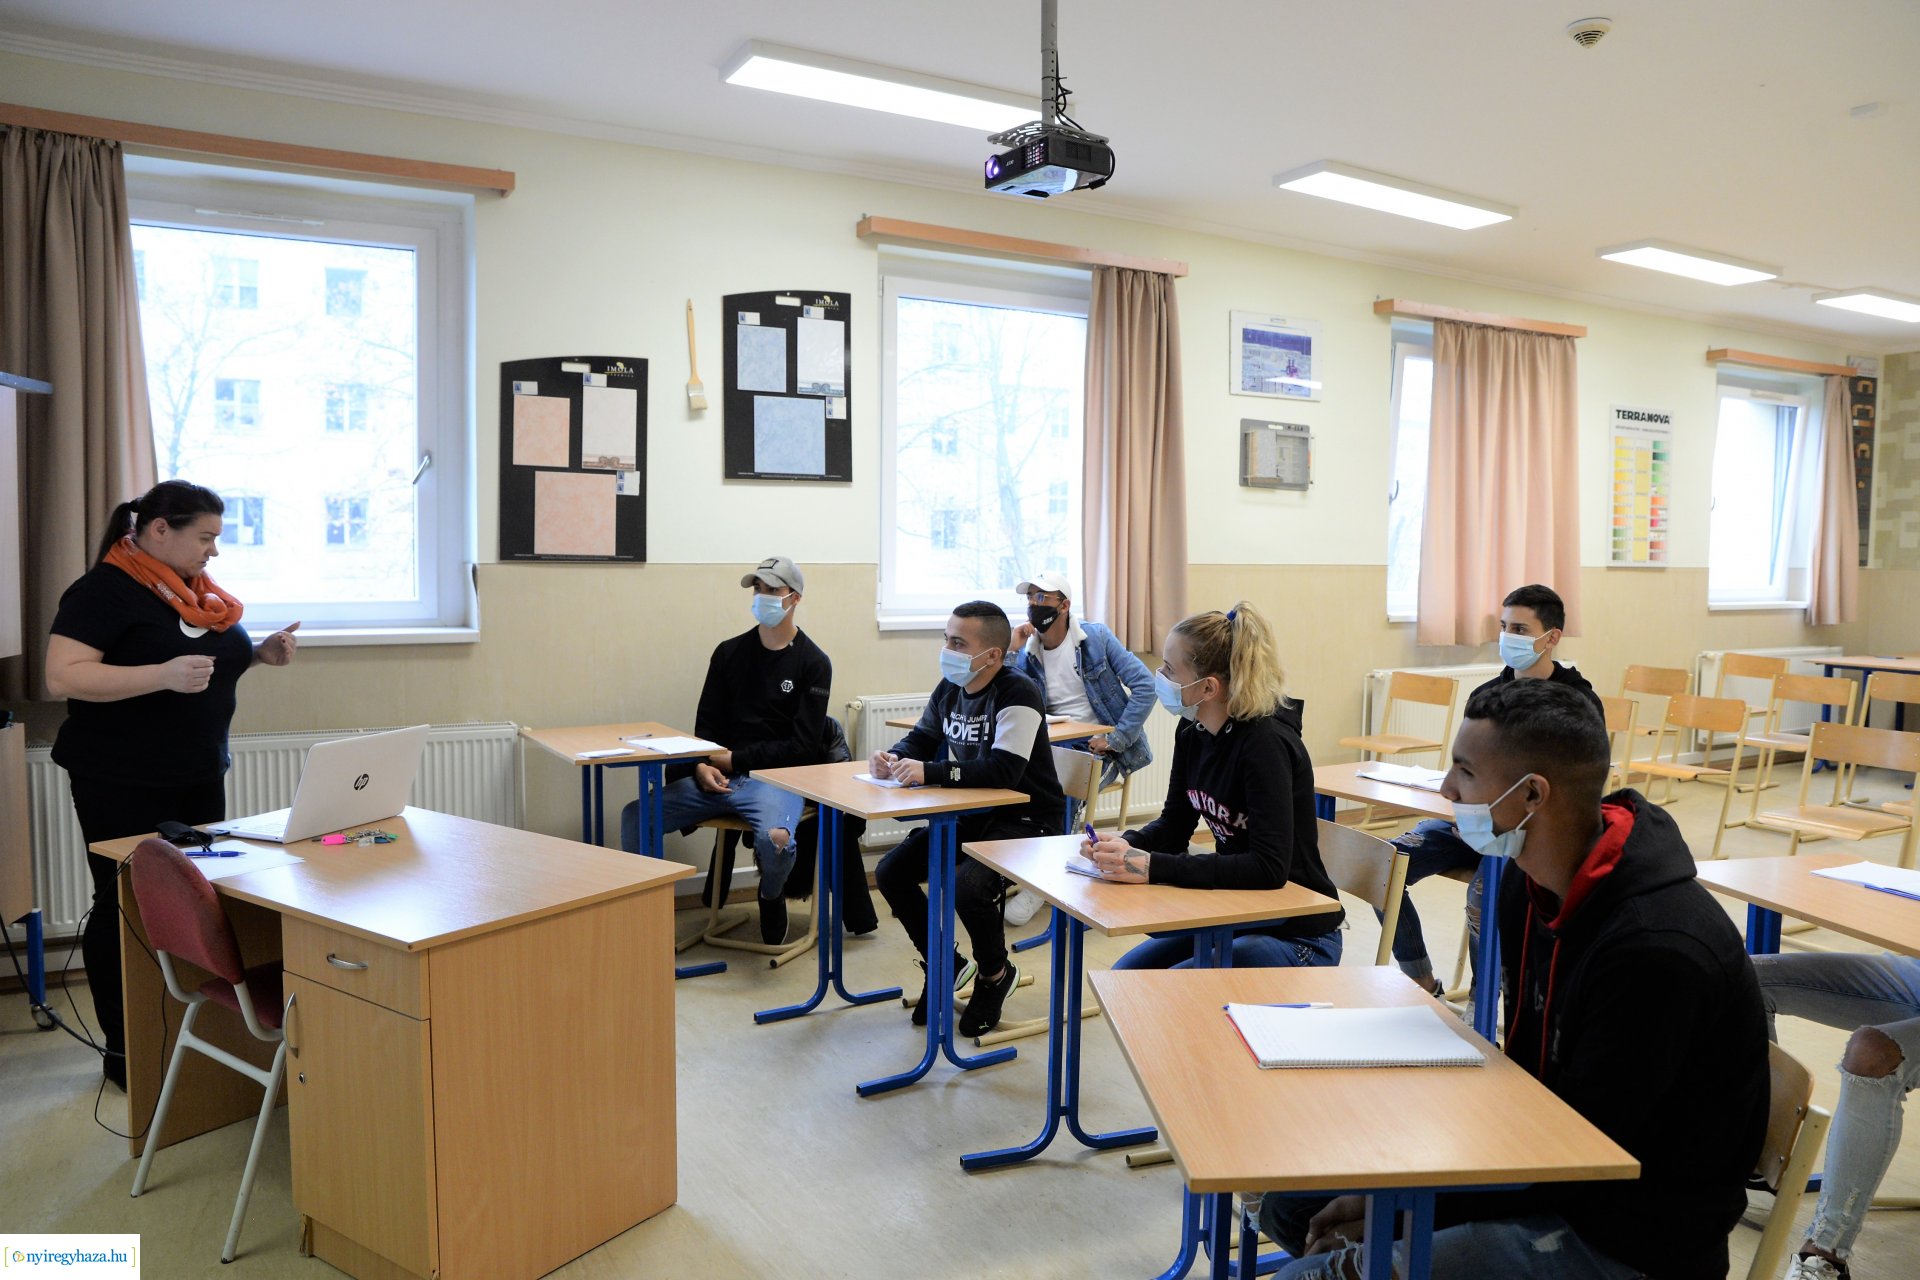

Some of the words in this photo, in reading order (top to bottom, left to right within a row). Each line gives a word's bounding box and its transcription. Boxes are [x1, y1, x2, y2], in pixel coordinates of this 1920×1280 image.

[815, 298, 839, 307] IMOLA
[607, 365, 634, 374] IMOLA
[1616, 409, 1670, 425] TERRANOVA
